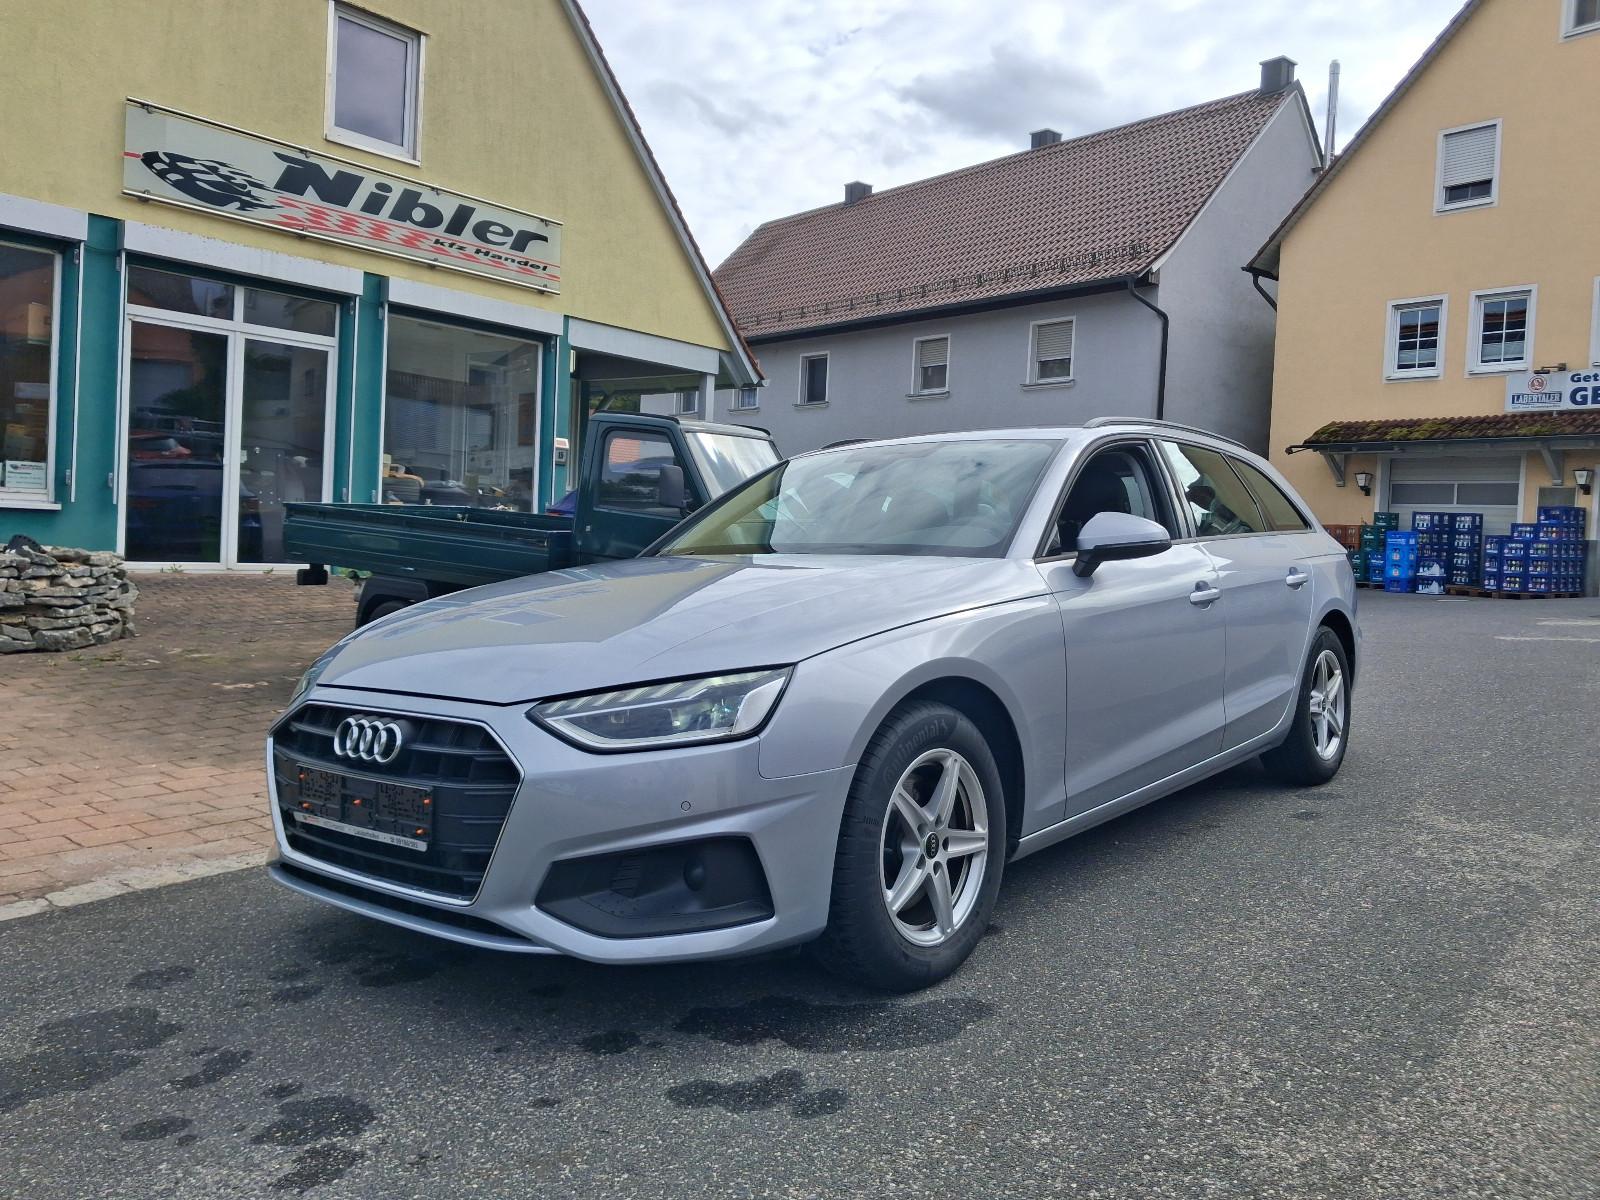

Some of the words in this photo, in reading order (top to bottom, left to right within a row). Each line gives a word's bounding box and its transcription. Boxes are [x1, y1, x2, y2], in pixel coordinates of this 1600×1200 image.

[272, 151, 549, 252] Nibler
[475, 249, 549, 273] Handel
[1514, 393, 1560, 404] LABERTALER
